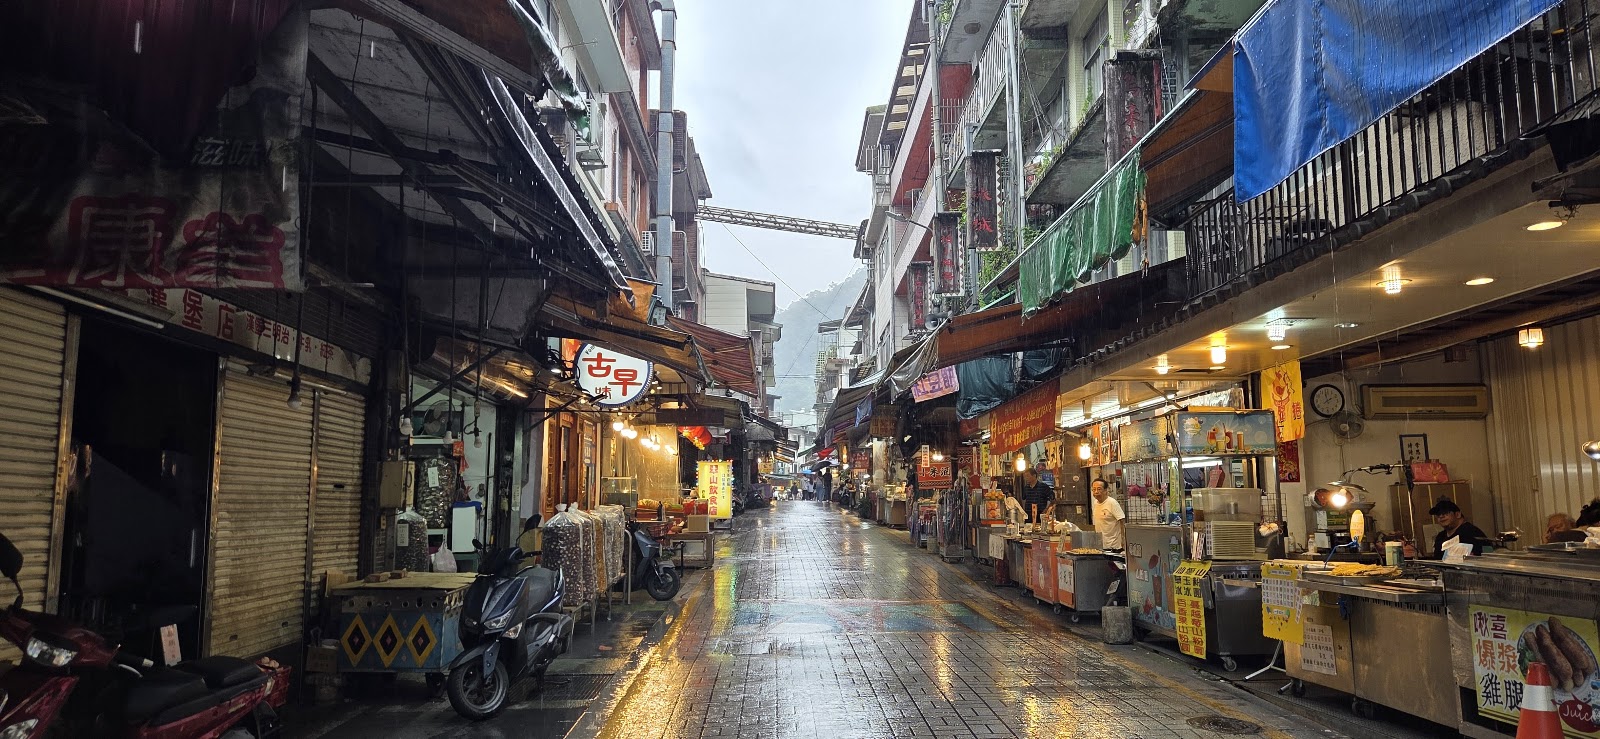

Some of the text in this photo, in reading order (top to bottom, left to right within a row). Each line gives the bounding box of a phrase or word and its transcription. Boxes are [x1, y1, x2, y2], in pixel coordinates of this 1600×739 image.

[1474, 611, 1508, 641] 啾喜
[1476, 639, 1519, 675] 爆漿
[1480, 672, 1524, 711] 雞腿
